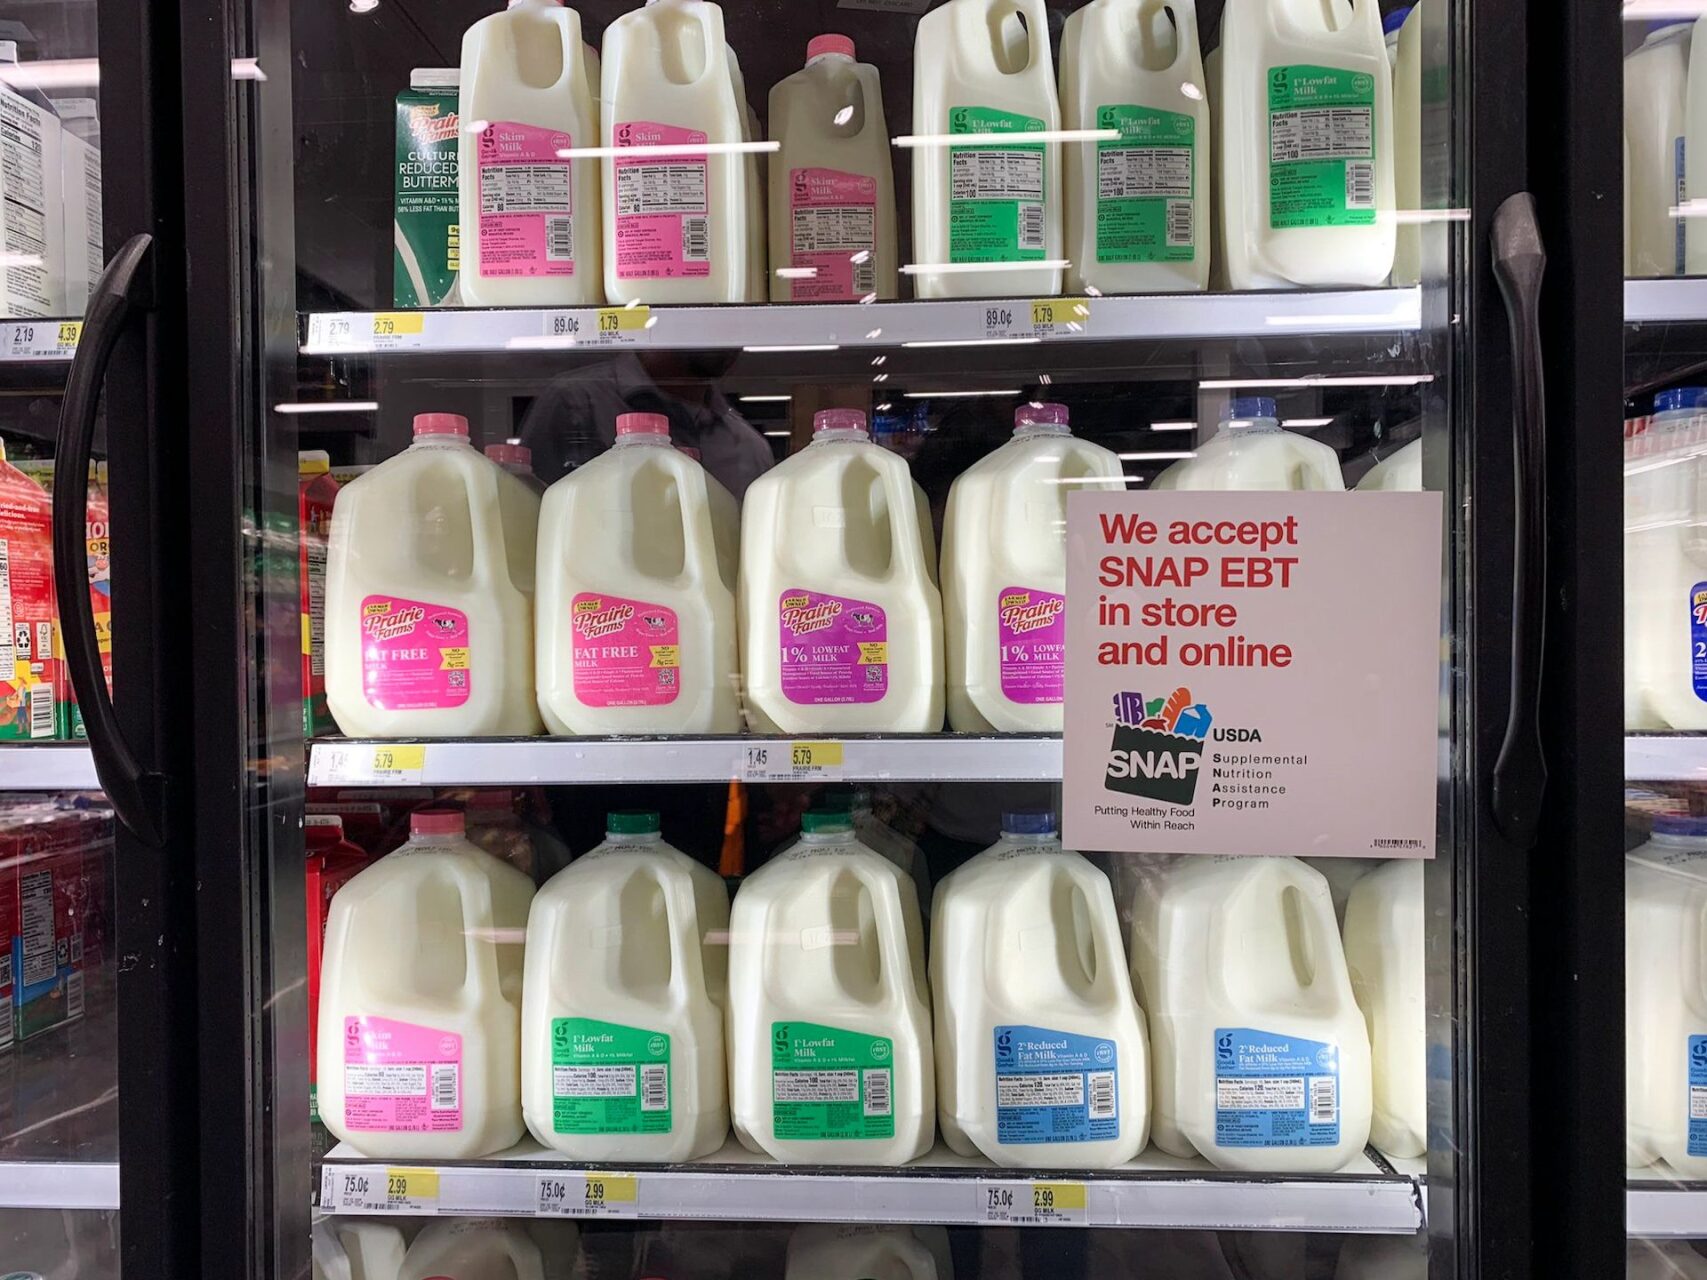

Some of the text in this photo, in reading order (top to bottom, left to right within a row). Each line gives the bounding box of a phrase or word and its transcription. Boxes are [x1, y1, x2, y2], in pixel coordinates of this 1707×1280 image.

[1303, 76, 1337, 85] Lowfat
[1293, 86, 1317, 95] Milk
[1130, 117, 1160, 126] Lowfat
[1272, 112, 1298, 120] Nutrition
[982, 119, 1012, 128] Lowfat
[499, 132, 525, 142] Skim
[635, 132, 661, 142] Skim
[499, 142, 523, 151] Milk
[1287, 150, 1298, 158] 100
[399, 162, 459, 174] REDUCED
[966, 190, 976, 198] 100
[1113, 187, 1123, 196] 100
[986, 307, 1053, 328] 89.0¢ 1.79
[373, 321, 394, 335] 2.79
[554, 315, 619, 335] 89.0¢ 1.79
[14, 327, 77, 342] 2.19 4.39
[1099, 513, 1298, 551] We accept
[1099, 556, 1299, 588] SNAP EBT
[782, 601, 842, 627] Prairie
[1001, 598, 1064, 626] Prairie
[1099, 595, 1237, 627] in store
[364, 606, 424, 634] Prairie
[574, 604, 633, 632] Prairie
[584, 620, 625, 640] Farms
[791, 617, 833, 636] Farms
[1011, 615, 1054, 634] Farms
[373, 622, 415, 640] Farms
[391, 648, 429, 661] FREE
[574, 646, 639, 659] FAT FREE
[781, 646, 808, 663] 1%
[812, 645, 850, 654] LOWFAT
[1001, 645, 1029, 662] 1%
[1098, 635, 1292, 668] and online
[812, 654, 837, 662] MILK
[1033, 653, 1060, 661] MILK
[1213, 728, 1262, 743] USDA
[374, 753, 393, 769] 5.79
[748, 749, 812, 765] 1.45 5.79
[1212, 753, 1308, 765] Supplemental
[1107, 750, 1201, 780] SNAP
[1212, 768, 1272, 779] Nutrition
[1212, 783, 1287, 794] Assistance
[1212, 798, 1269, 810] Program
[1094, 805, 1195, 818] Putting Healthy Food
[1130, 820, 1195, 831] Within Reach
[582, 1033, 614, 1043] Lowfat
[802, 1038, 835, 1047] Lowfat
[573, 1044, 594, 1052] Milk
[1027, 1040, 1067, 1050] Reduced
[1249, 1043, 1289, 1053] Reduced
[794, 1048, 816, 1057] Milk
[1018, 1051, 1033, 1060] Fat
[1034, 1049, 1057, 1059] Milk
[1239, 1053, 1278, 1063] Fat Milk
[345, 1176, 407, 1196] 75.0¢ 2.99
[541, 1182, 604, 1201] 75.0¢ 2.99
[988, 1189, 1054, 1209] 75.0¢ 2.99
